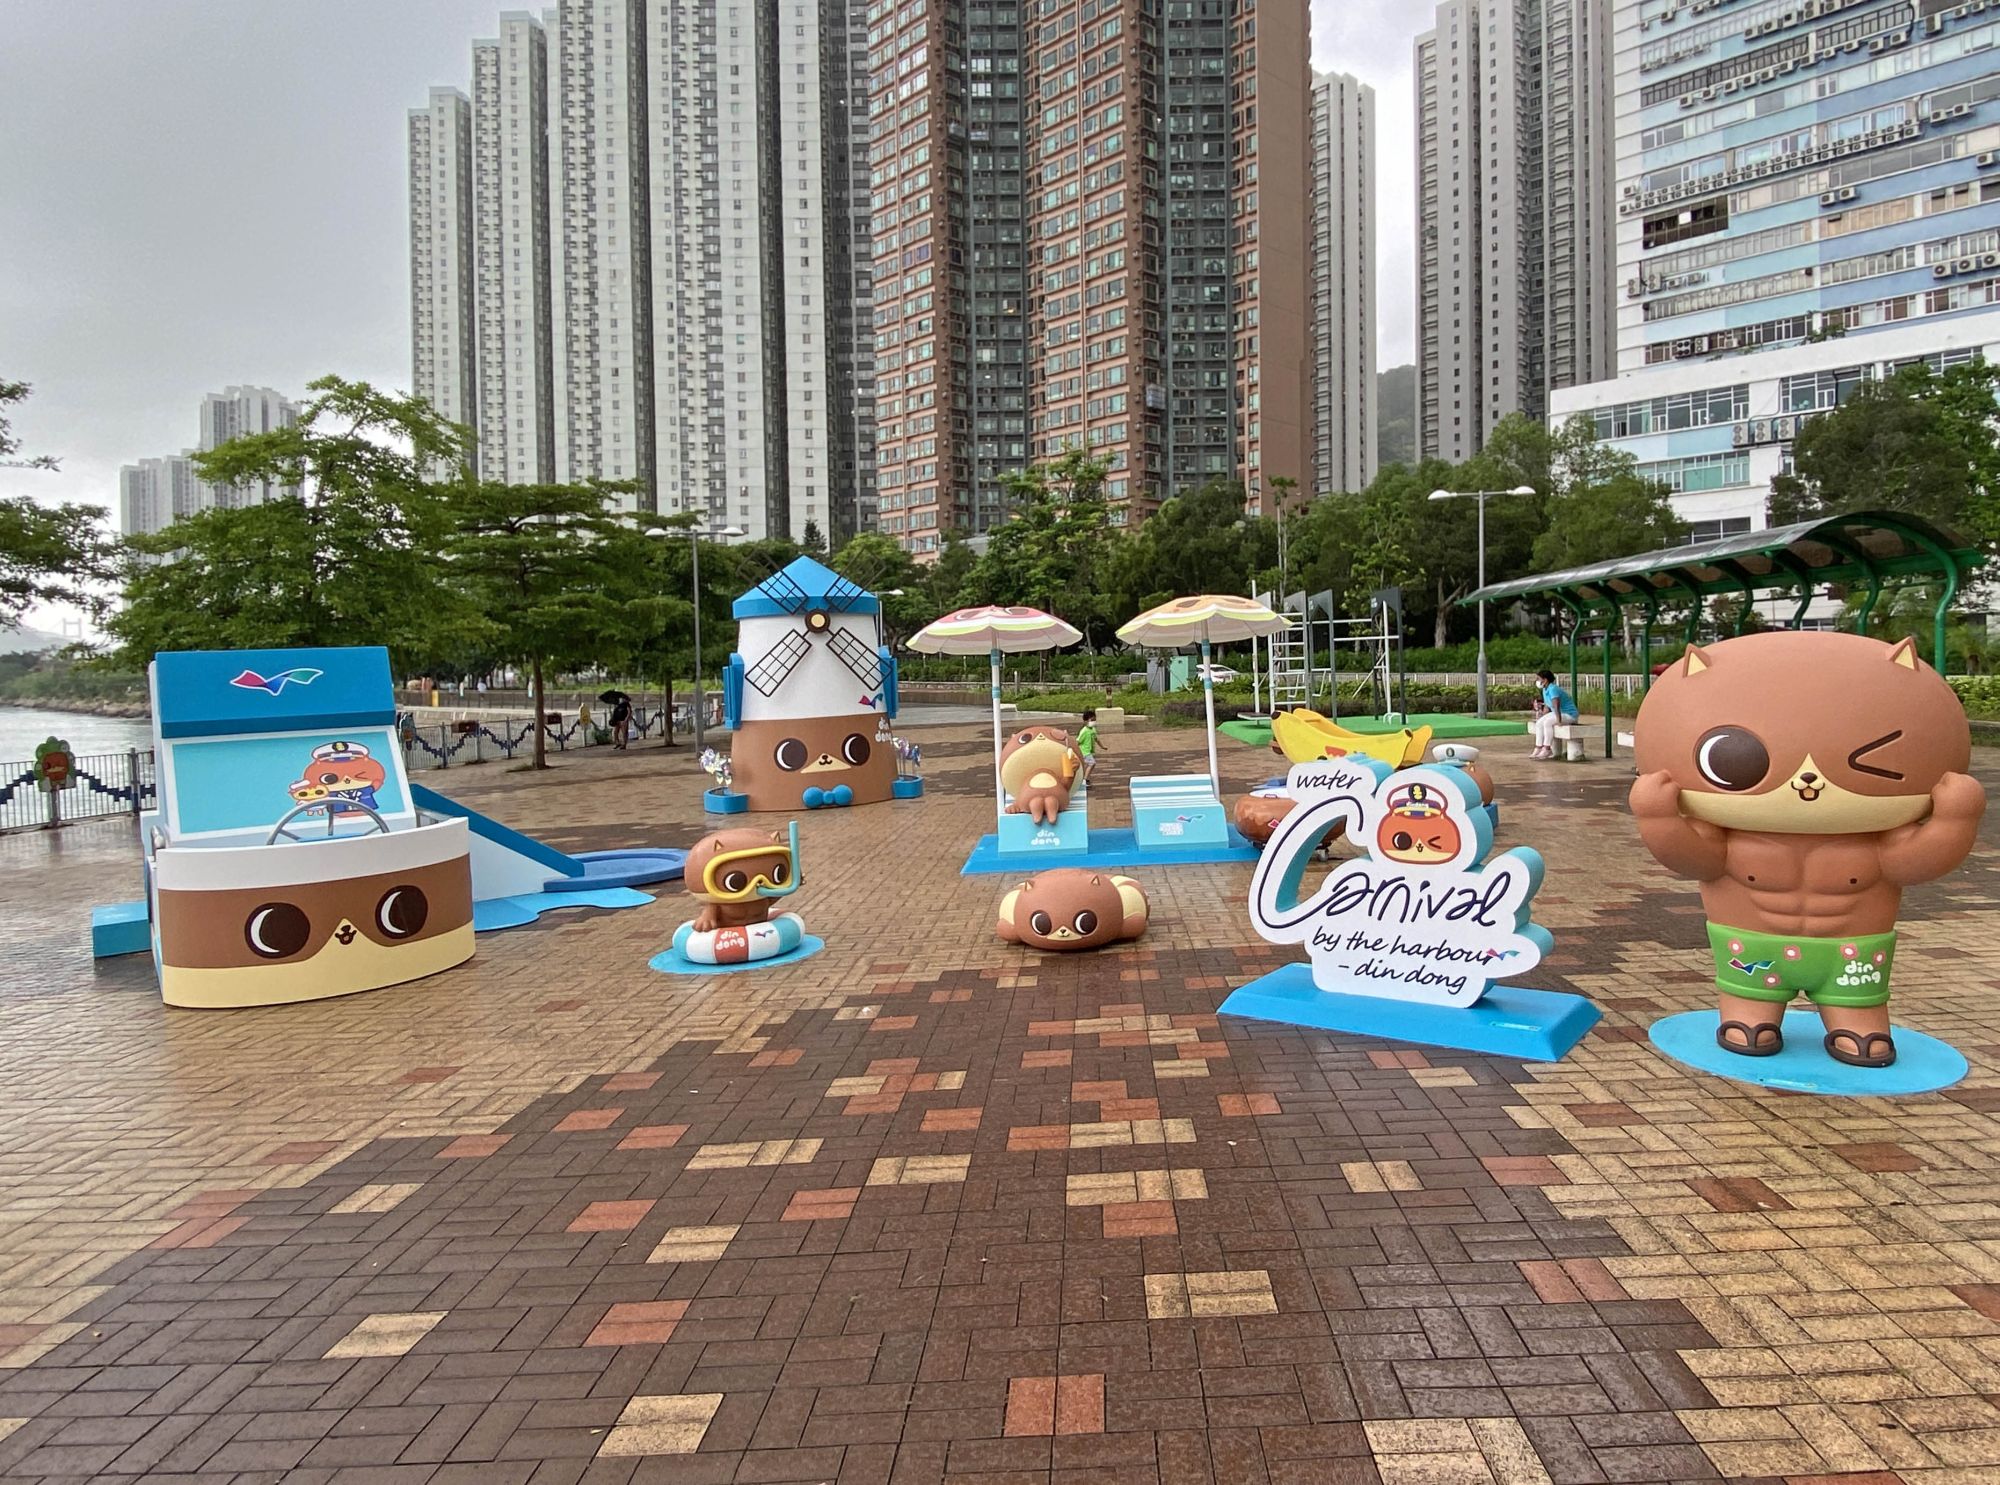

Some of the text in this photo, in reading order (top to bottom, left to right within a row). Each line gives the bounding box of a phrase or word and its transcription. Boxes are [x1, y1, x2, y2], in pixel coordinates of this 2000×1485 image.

[1296, 770, 1362, 790] water
[1037, 829, 1055, 838] din
[1258, 796, 1511, 929] Carnival
[720, 930, 739, 940] din
[715, 937, 745, 950] dong
[1312, 926, 1494, 967] by the harbour
[1844, 960, 1874, 974] din
[1354, 959, 1405, 980] din
[1405, 965, 1467, 994] dong
[1836, 971, 1881, 986] dong
